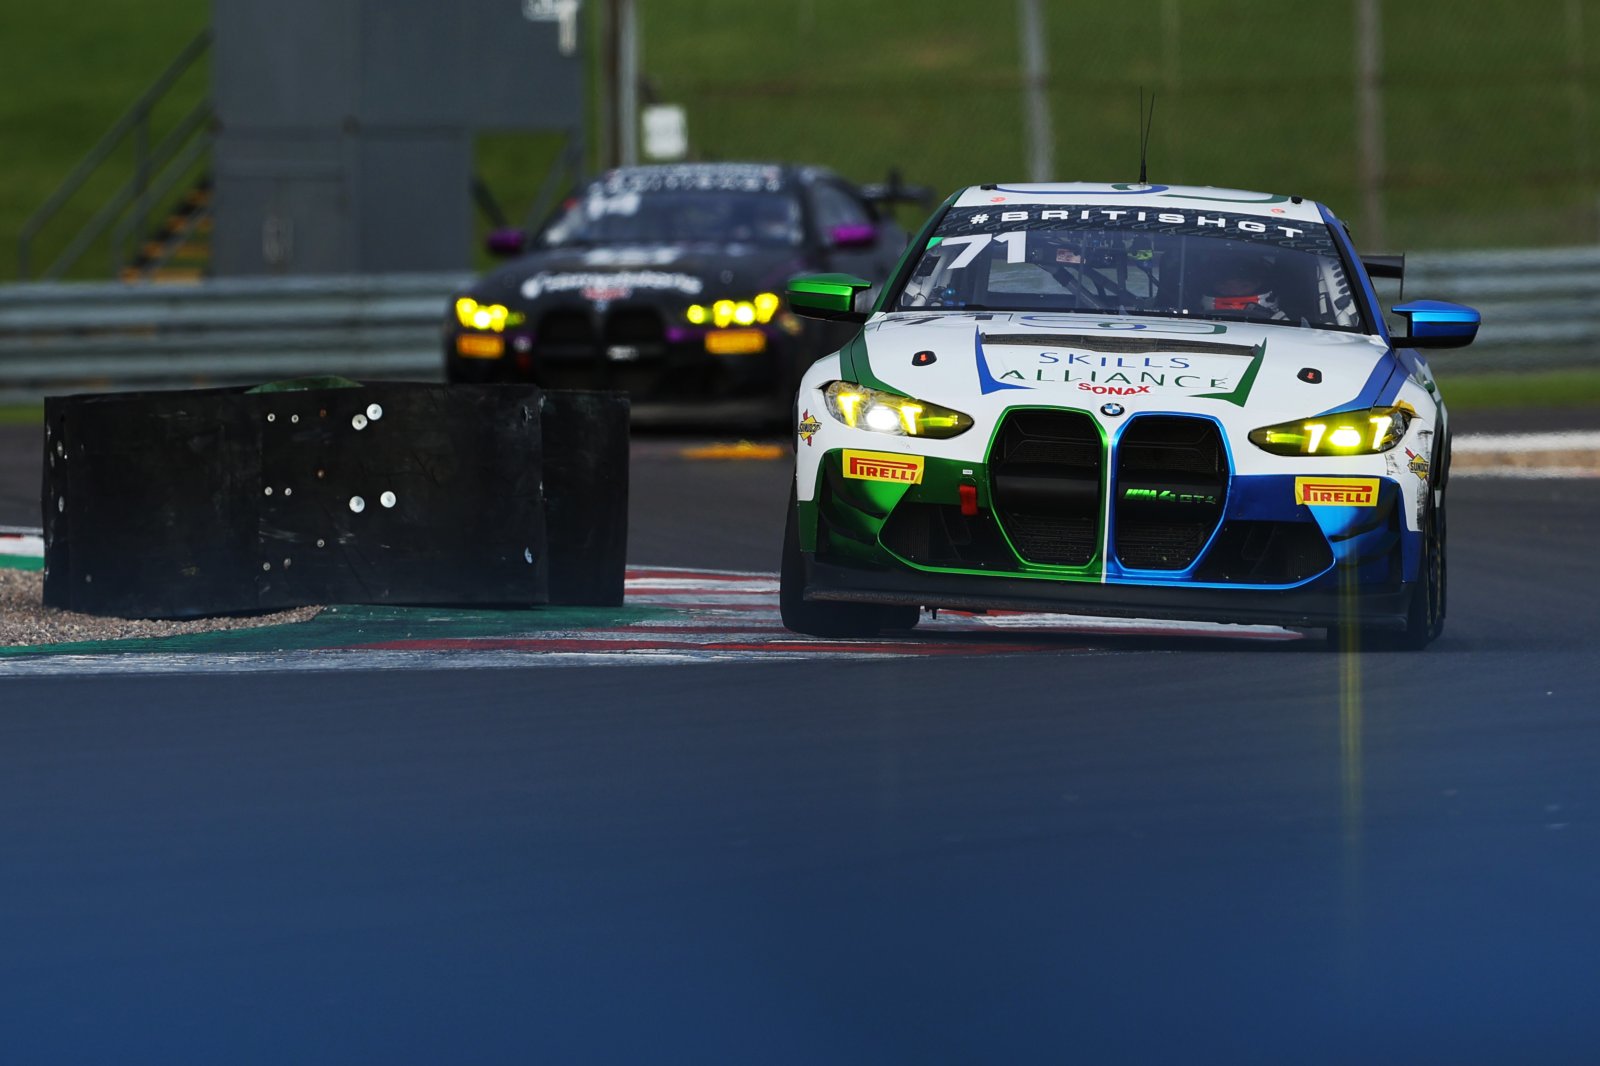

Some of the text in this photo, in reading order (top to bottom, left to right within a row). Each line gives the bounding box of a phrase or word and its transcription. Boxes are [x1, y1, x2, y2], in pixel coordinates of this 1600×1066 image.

[970, 209, 1304, 239] #BRITISHGT
[939, 231, 1027, 270] 71
[1038, 351, 1190, 370] SKILLS
[999, 368, 1229, 390] ALLIANCE
[1077, 382, 1151, 396] SONAX
[849, 456, 919, 482] PIRELLI
[1302, 483, 1374, 504] PIRELLI
